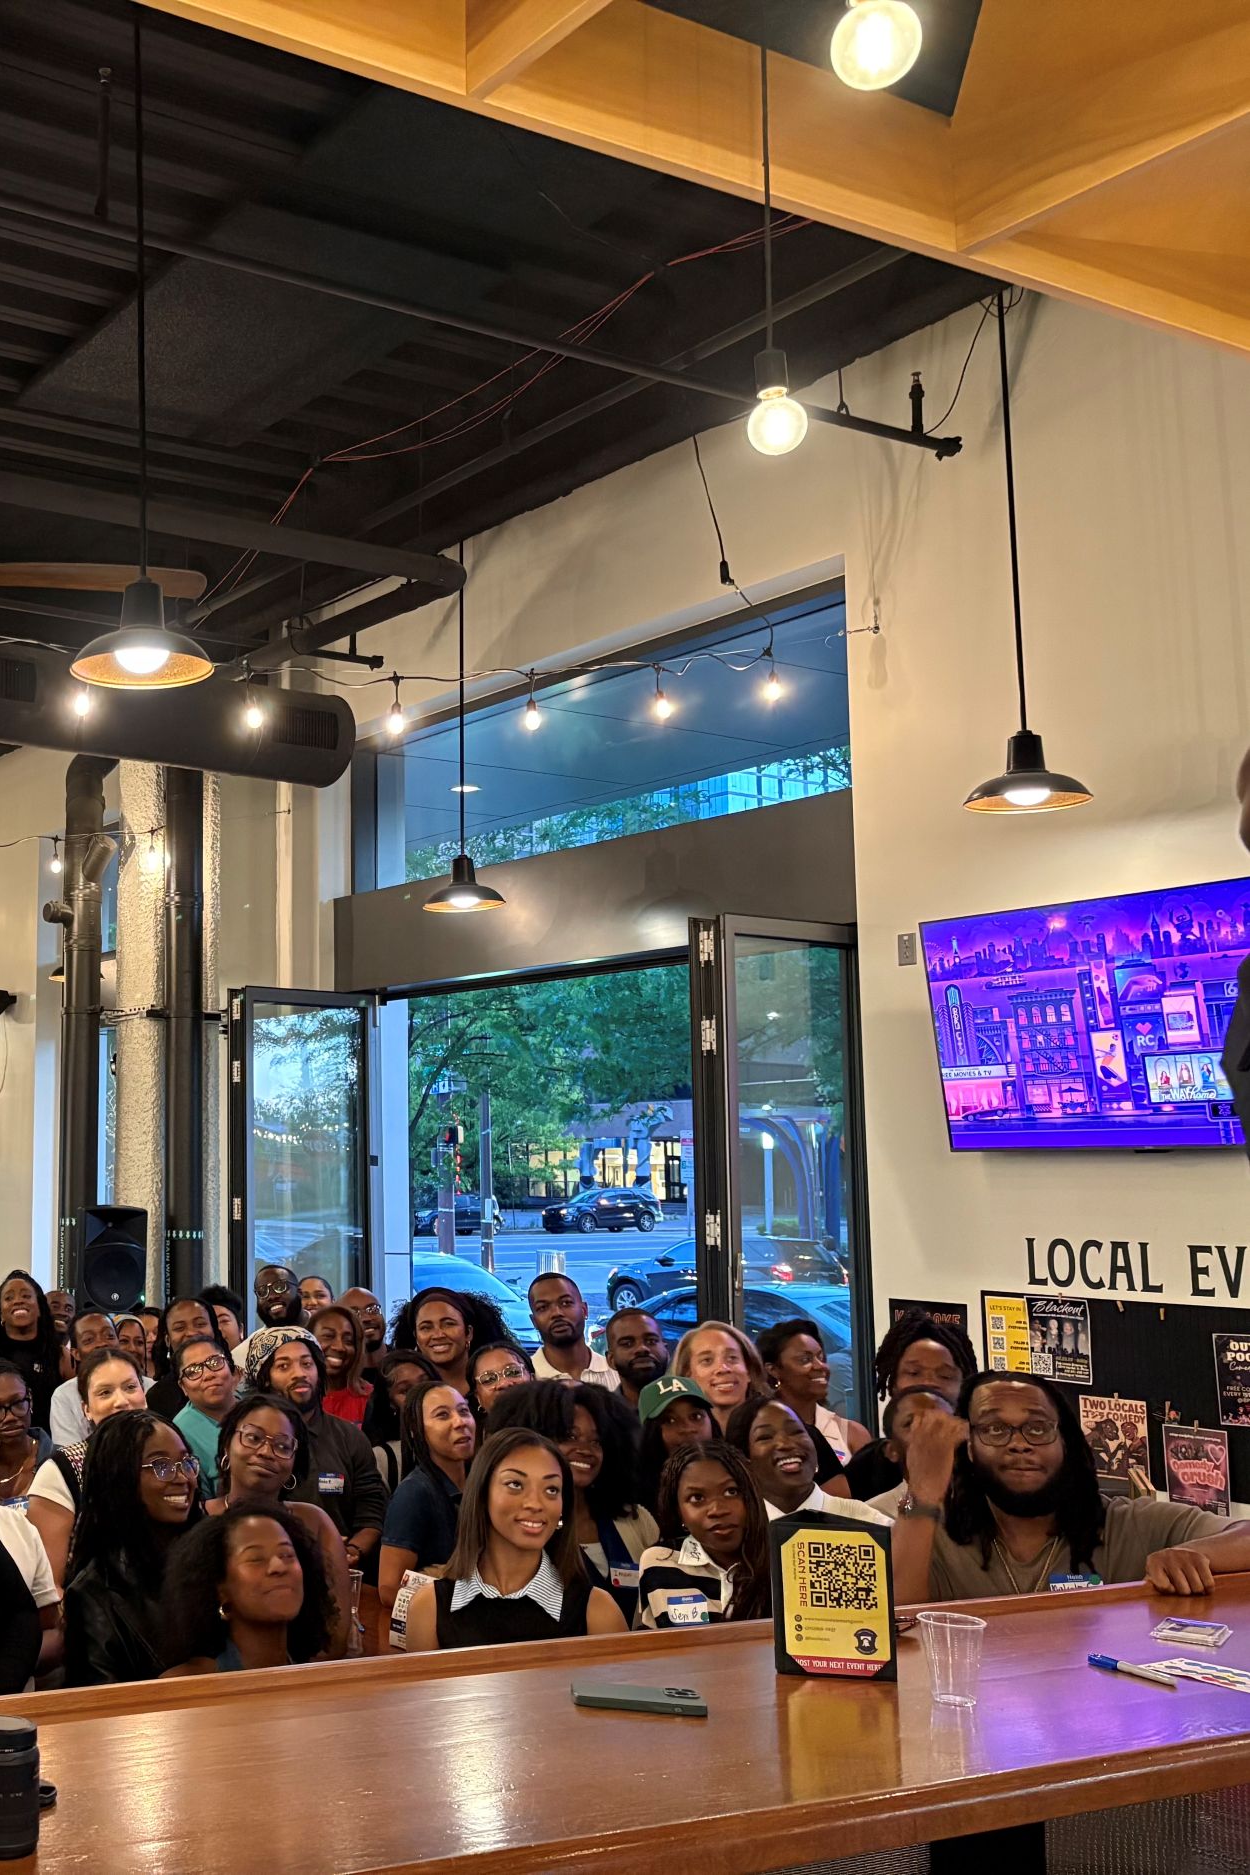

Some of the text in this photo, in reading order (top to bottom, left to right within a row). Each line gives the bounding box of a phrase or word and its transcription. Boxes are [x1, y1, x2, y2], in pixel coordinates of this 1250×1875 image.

[1137, 1034, 1155, 1046] RC
[1025, 1237, 1247, 1299] LOCAL EV
[1031, 1300, 1084, 1316] Blackout
[657, 1379, 688, 1395] LA
[1081, 1397, 1145, 1415] TWO LOCALS
[1106, 1412, 1146, 1425] COMEDY
[797, 1542, 808, 1607] SCAN HERE
[812, 1660, 828, 1668] YOUR
[847, 1662, 864, 1670] EVENT
